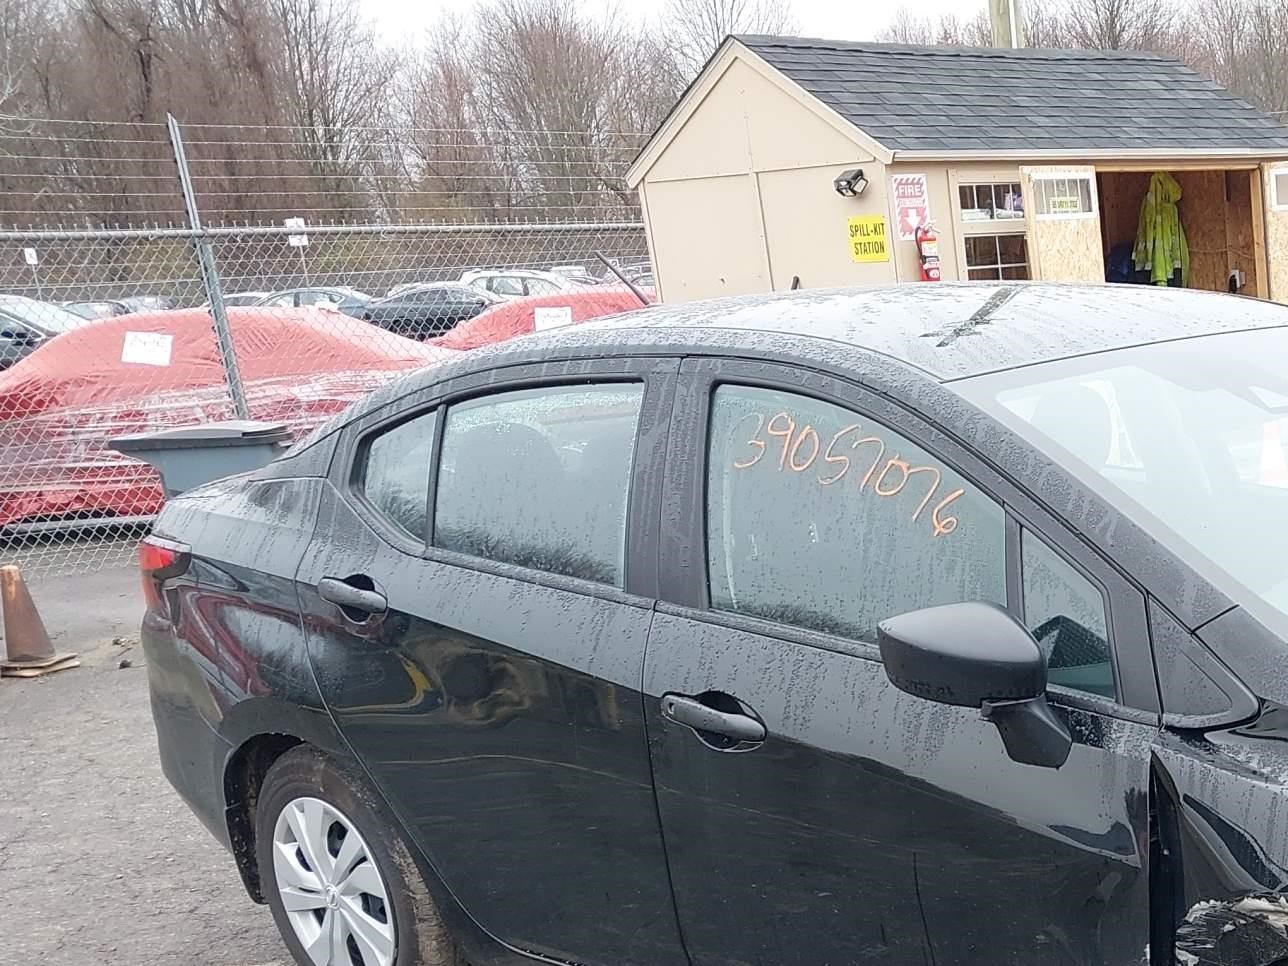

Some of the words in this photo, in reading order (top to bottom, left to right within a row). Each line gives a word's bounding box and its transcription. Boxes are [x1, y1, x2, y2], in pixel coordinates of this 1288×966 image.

[898, 184, 922, 197] FIRE
[849, 222, 885, 238] SPILL-KIT
[854, 241, 885, 255] STATION
[734, 411, 964, 537] 39057076
